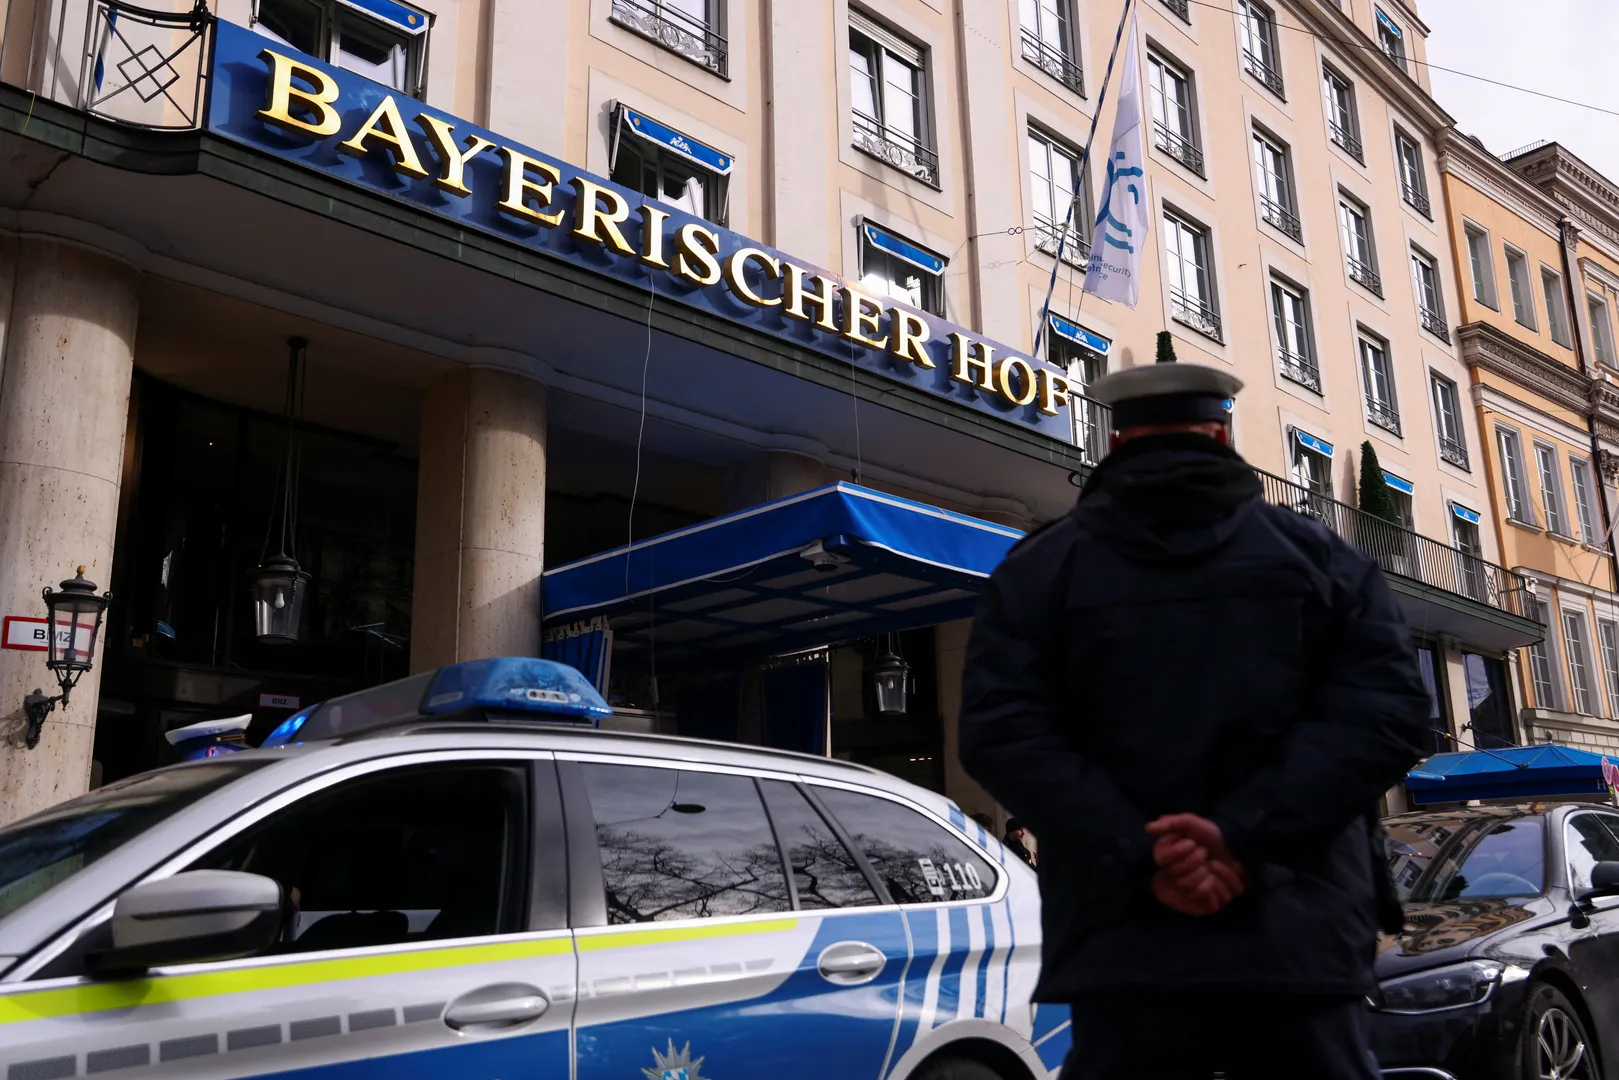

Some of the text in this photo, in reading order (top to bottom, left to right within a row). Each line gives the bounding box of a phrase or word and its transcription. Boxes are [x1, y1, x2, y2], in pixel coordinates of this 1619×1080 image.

[256, 48, 1070, 416] BAYERISCHER HOF
[1101, 262, 1132, 278] ecurity
[943, 862, 981, 890] 110
